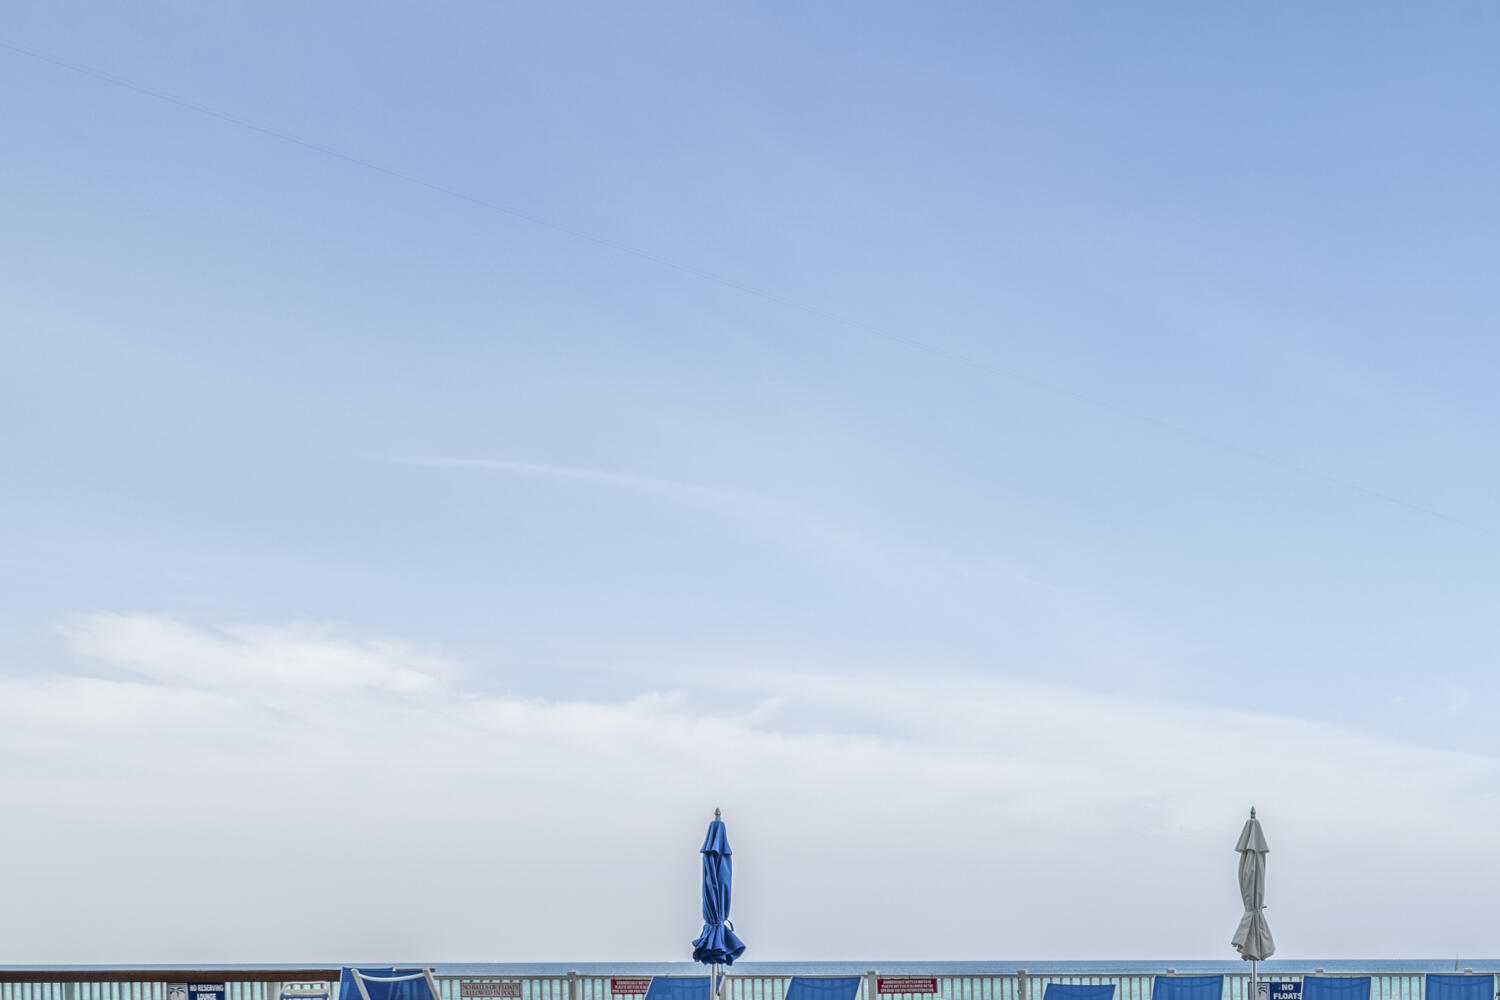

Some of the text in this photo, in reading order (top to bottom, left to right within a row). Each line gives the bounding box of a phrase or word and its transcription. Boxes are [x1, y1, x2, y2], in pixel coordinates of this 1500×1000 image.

[1281, 983, 1294, 991] NO
[196, 993, 217, 1000] LOUNGE
[1273, 992, 1302, 1000] FLOATS
